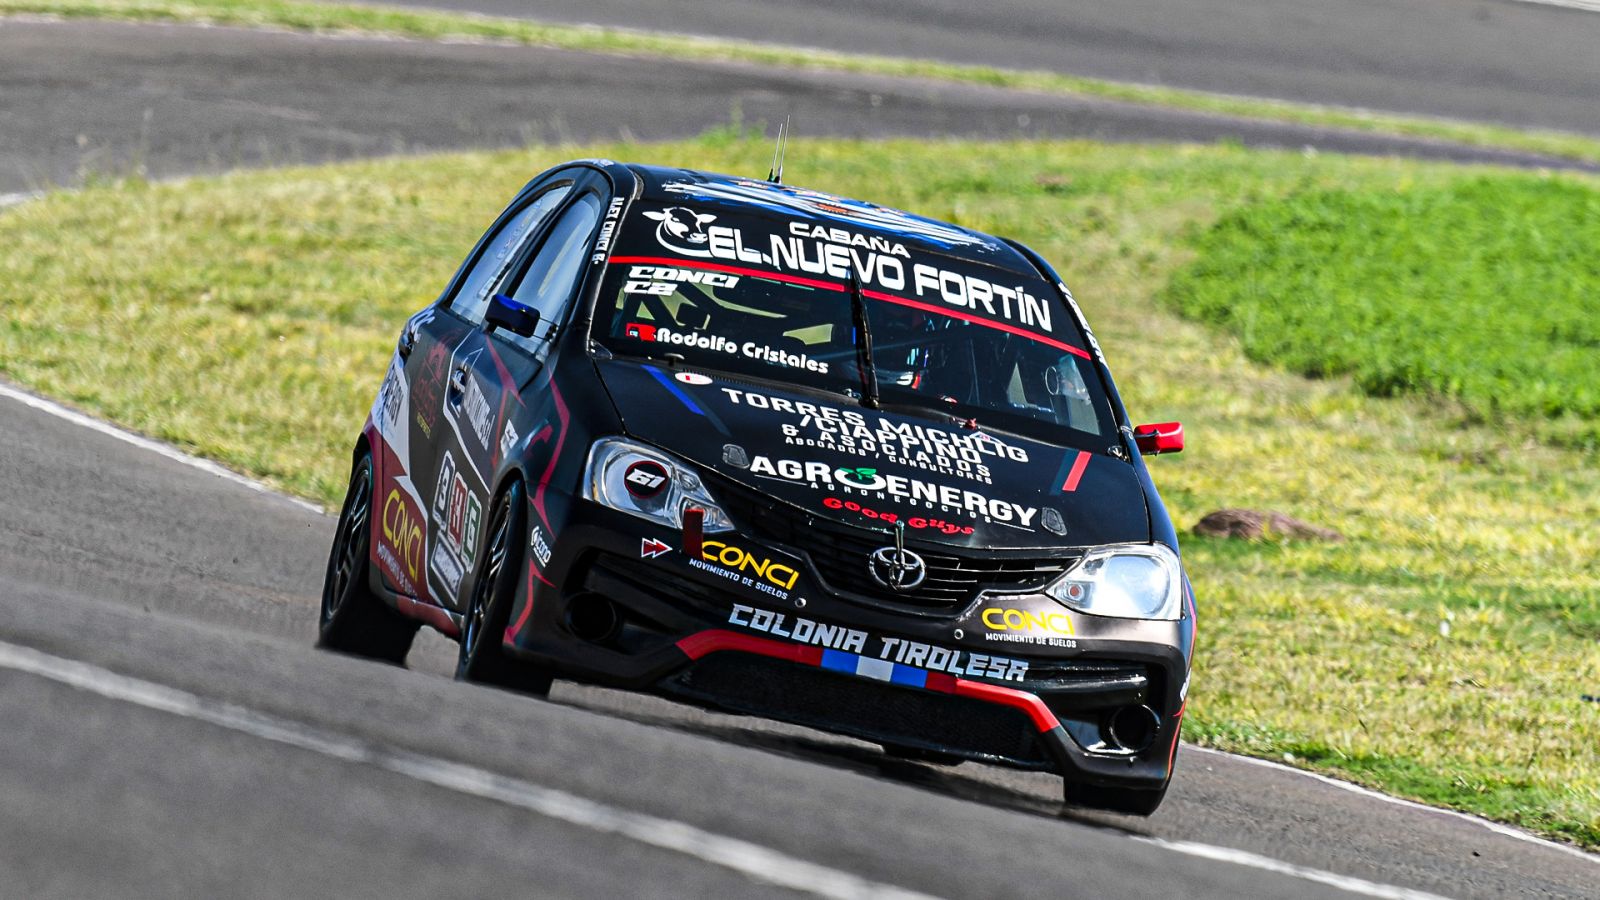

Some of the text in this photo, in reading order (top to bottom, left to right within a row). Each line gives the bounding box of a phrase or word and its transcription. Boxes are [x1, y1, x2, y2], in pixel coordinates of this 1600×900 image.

[789, 221, 911, 259] CABAÑA
[628, 265, 740, 289] CONCI
[708, 225, 763, 264] EL
[770, 233, 905, 291] NUEVO
[913, 263, 1052, 333] FORTÍN
[656, 328, 738, 354] Rodolfo
[742, 342, 829, 374] Cristales
[721, 387, 1029, 463] TORRES MICHLIG
[781, 423, 991, 477] & ASOCIADOS
[785, 436, 867, 457] ABOGADOS
[889, 455, 993, 485] CONSULTORES
[626, 468, 666, 489] 61
[750, 455, 1038, 527] AGROENERGY
[810, 482, 992, 524] AGRONEGOCIOS
[822, 497, 975, 535] Good Guys
[382, 488, 423, 583] CONCI
[689, 558, 788, 600] MOVIMIENTO DE SUELOS
[701, 540, 800, 591] CONCI
[728, 602, 1030, 682] COLONIA TIROLESA
[981, 607, 1075, 636] CONCI
[985, 632, 1077, 648] MOVIMIENTO DE SUELOS
